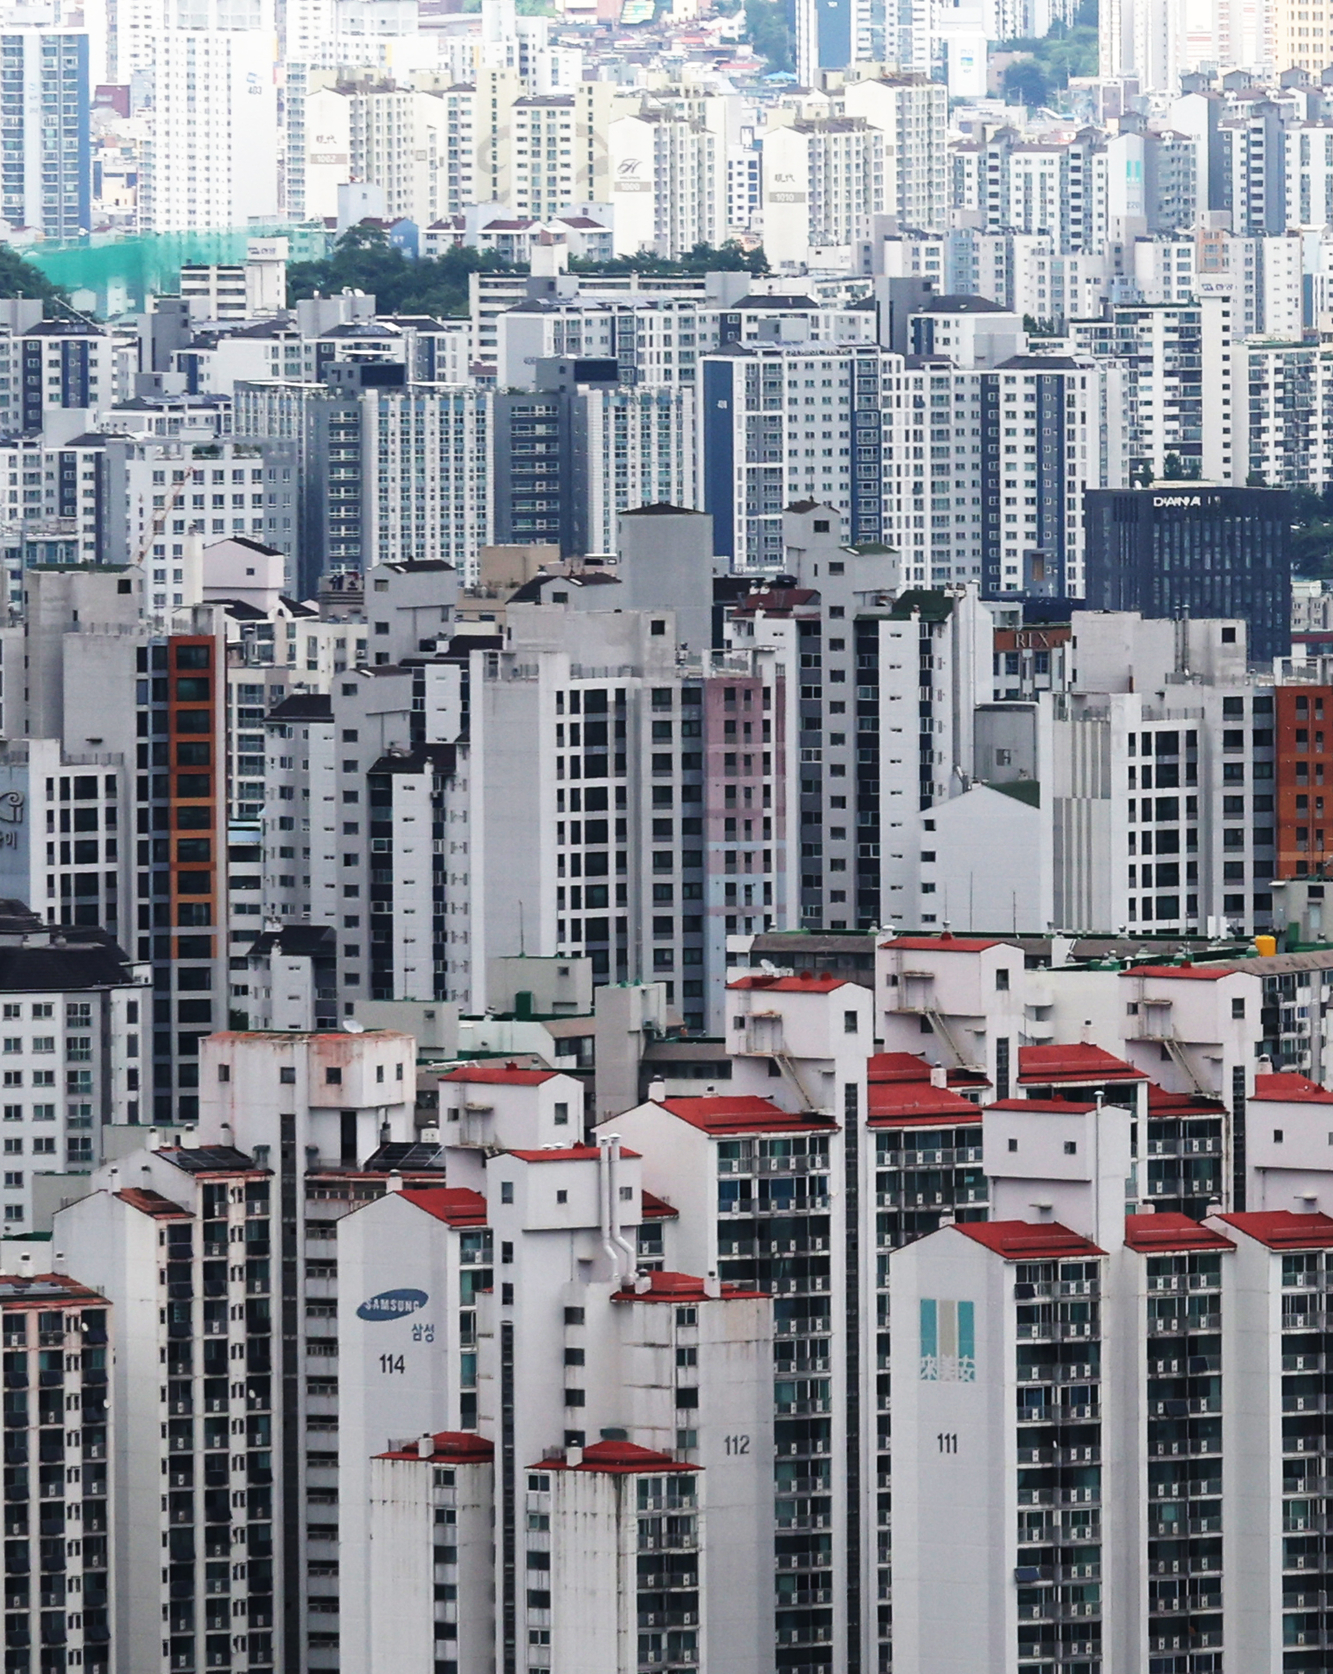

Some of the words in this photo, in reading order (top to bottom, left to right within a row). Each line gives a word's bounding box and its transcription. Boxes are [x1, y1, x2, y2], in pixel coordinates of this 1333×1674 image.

[364, 1297, 421, 1314] SAMSUNG
[411, 1323, 436, 1344] 삼성
[378, 1353, 406, 1375] 114
[723, 1435, 751, 1456] 112
[936, 1432, 959, 1454] 111
